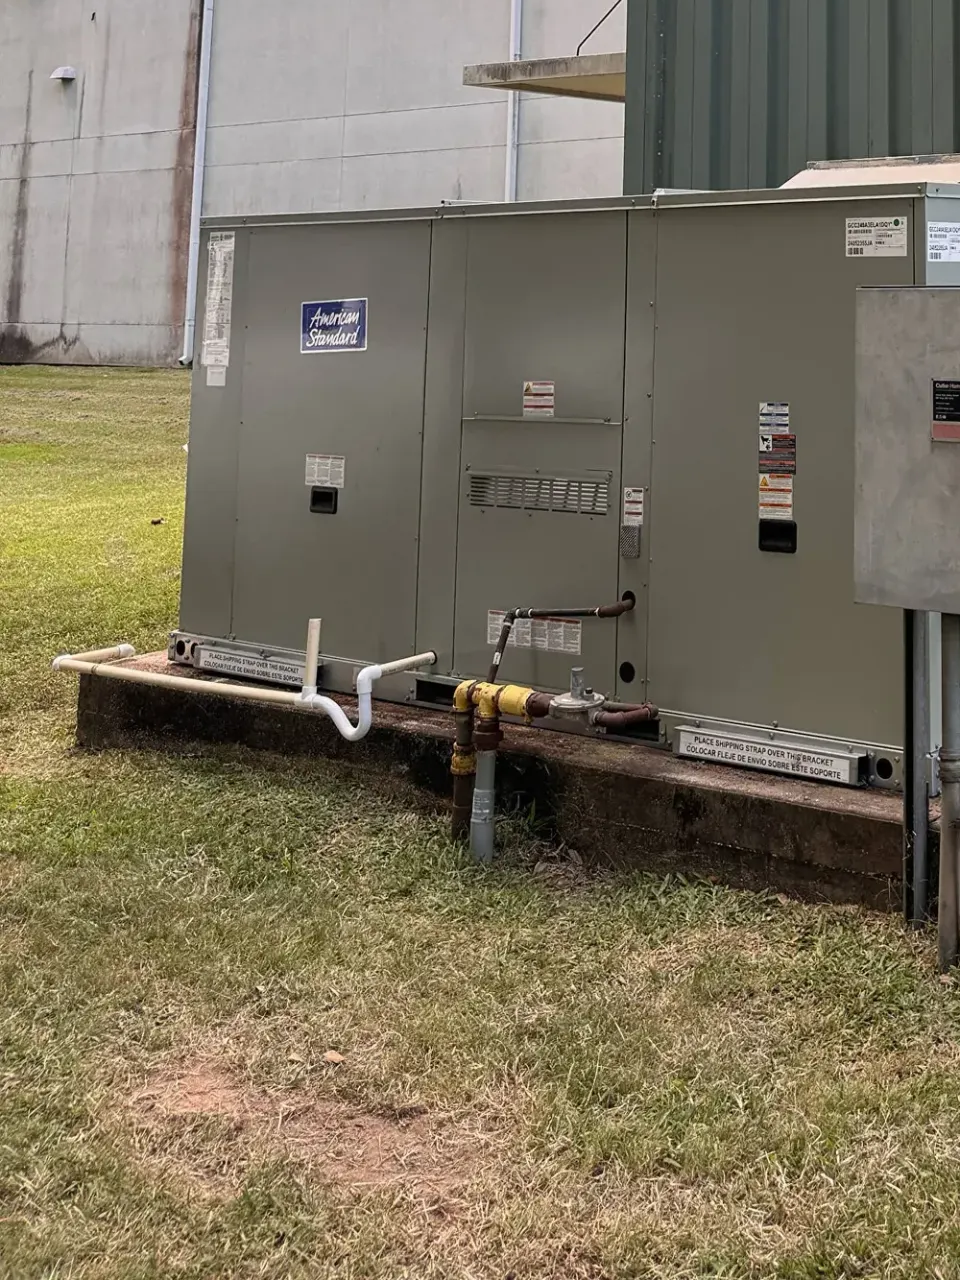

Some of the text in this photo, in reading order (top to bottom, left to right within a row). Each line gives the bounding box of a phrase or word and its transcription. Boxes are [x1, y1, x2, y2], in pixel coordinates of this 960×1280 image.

[309, 307, 360, 328] American
[306, 325, 360, 347] Standard
[208, 652, 222, 661] PLACE
[278, 665, 299, 674] BRACKET
[256, 670, 271, 678] SOBRE
[271, 672, 283, 680] ESTE
[283, 674, 304, 684] SOPORTE
[686, 745, 716, 757] COLOCAR
[717, 751, 736, 761] FLEJE
[737, 754, 746, 763] DE
[768, 760, 790, 770] SOBRE
[791, 763, 808, 774] ESTE
[809, 766, 841, 780] SOPORTE
[694, 736, 834, 767] PLACE SHIPPING STRAP OVER THIS BRACKET
